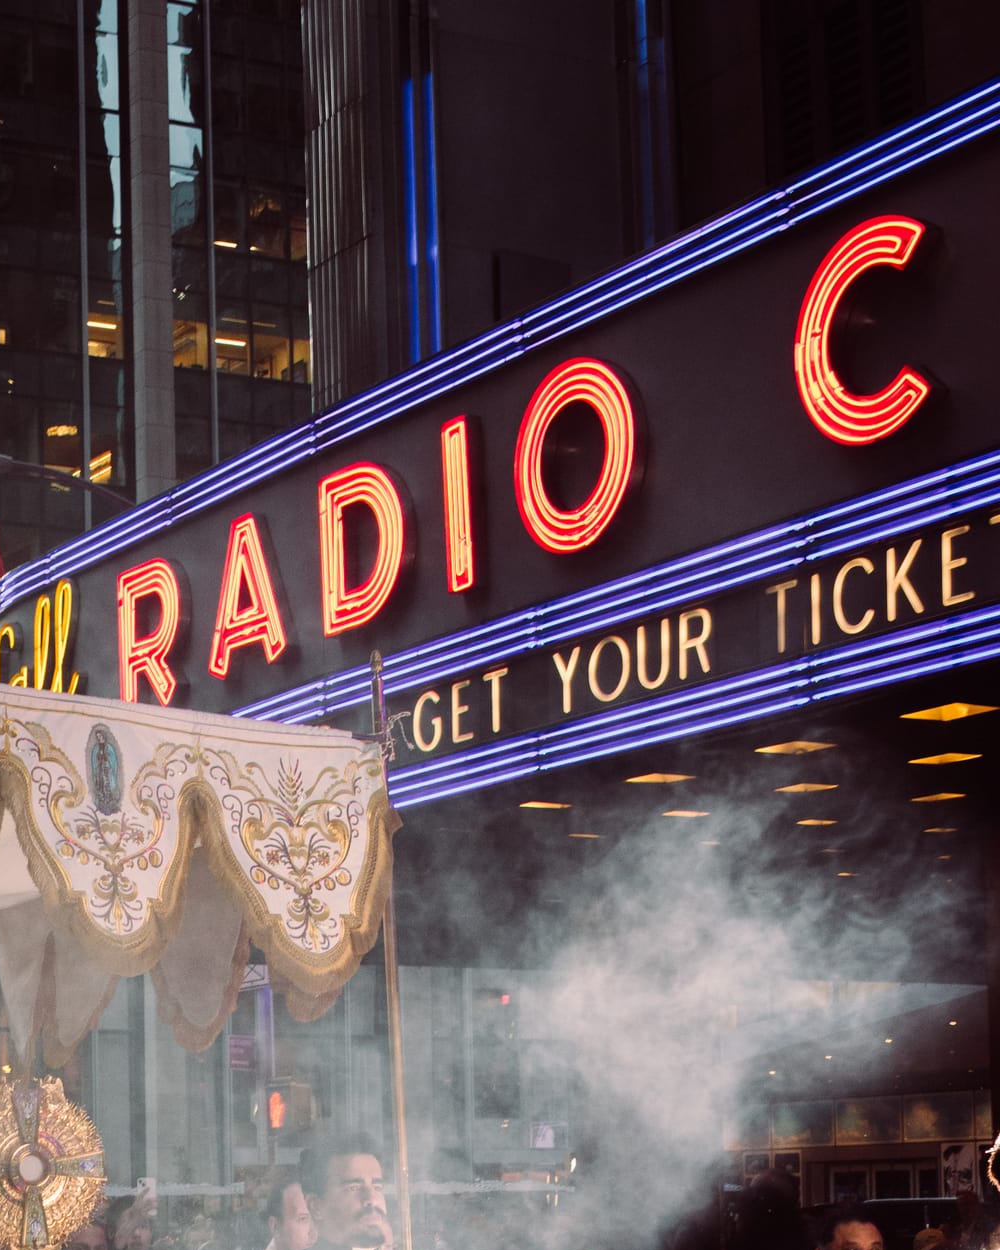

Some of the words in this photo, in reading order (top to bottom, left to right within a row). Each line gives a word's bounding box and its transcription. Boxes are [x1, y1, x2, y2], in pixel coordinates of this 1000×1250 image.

[117, 356, 636, 706] RADIO
[412, 667, 508, 752] GET
[553, 607, 712, 714] YOUR
[766, 514, 1000, 654] TICKE
